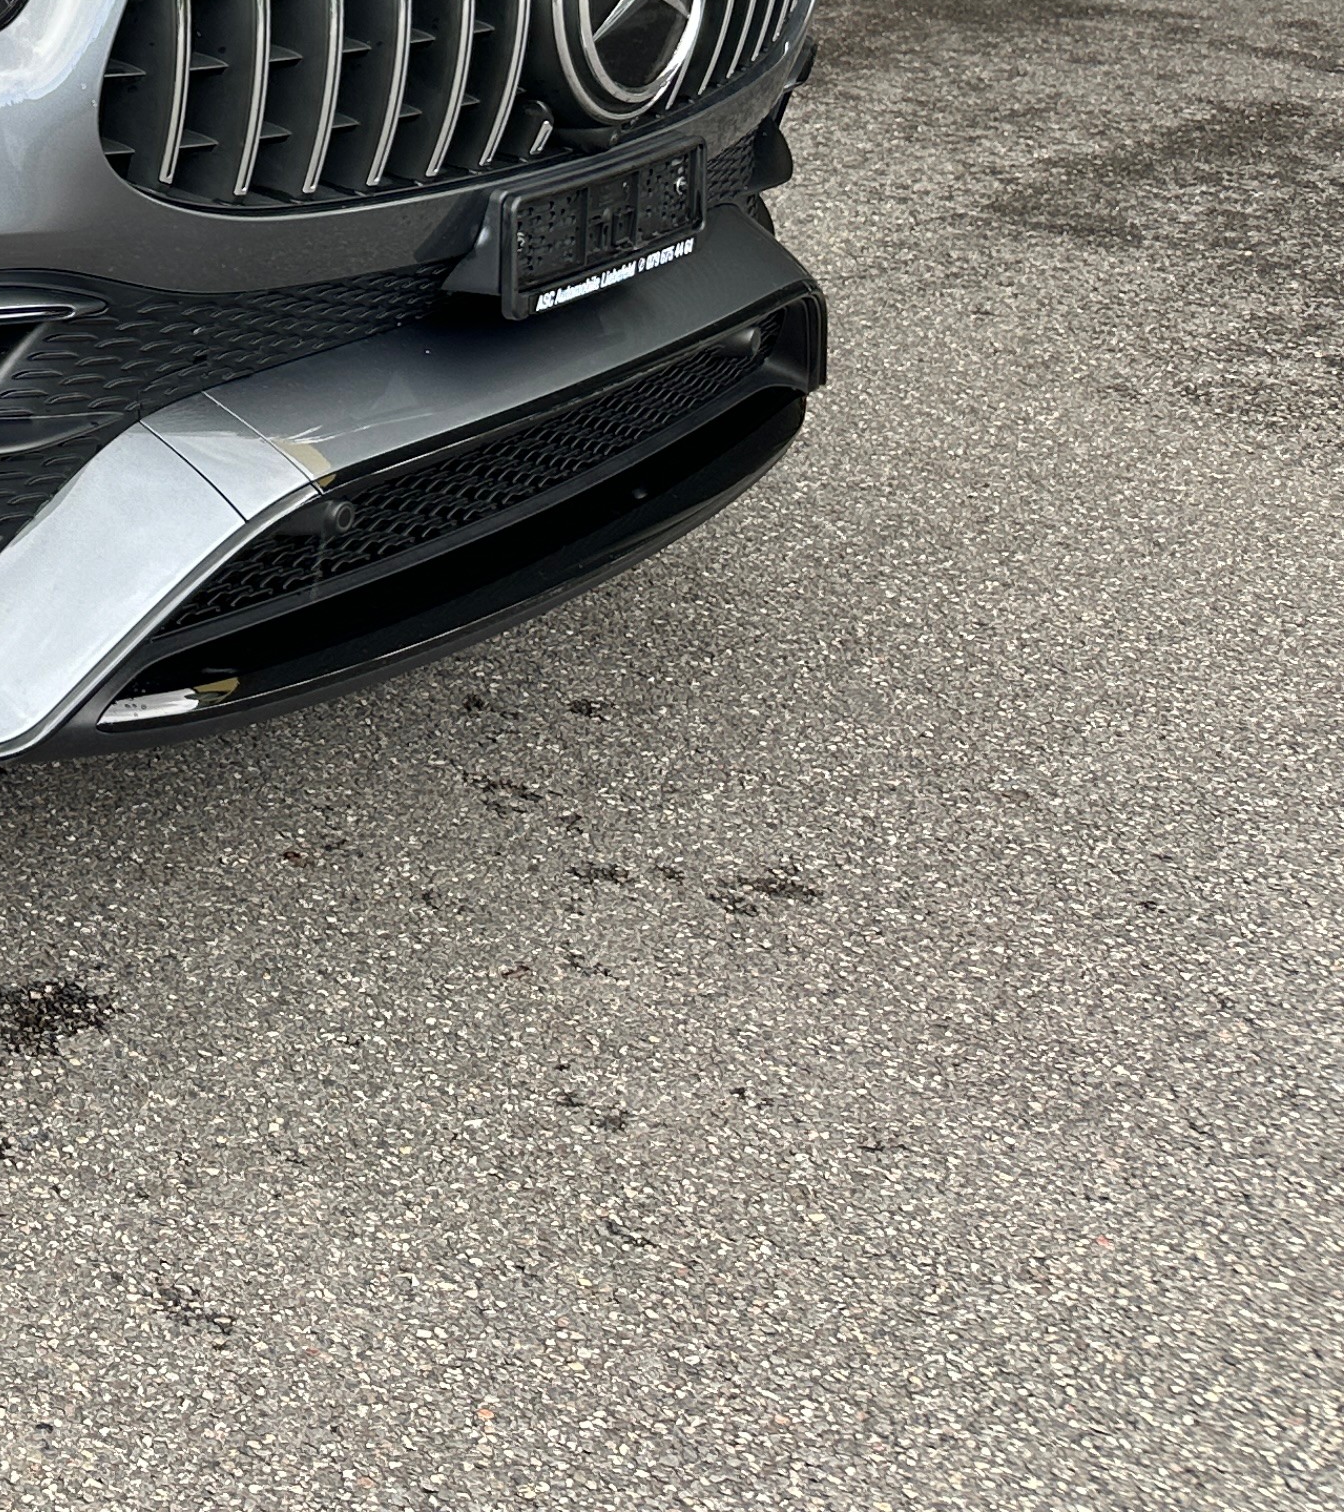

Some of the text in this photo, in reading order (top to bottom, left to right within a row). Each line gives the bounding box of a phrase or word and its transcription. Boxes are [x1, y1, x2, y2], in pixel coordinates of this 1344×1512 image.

[535, 290, 556, 312] ASC
[555, 276, 601, 306] Automobile
[646, 250, 661, 270] 079
[675, 242, 684, 258] 44
